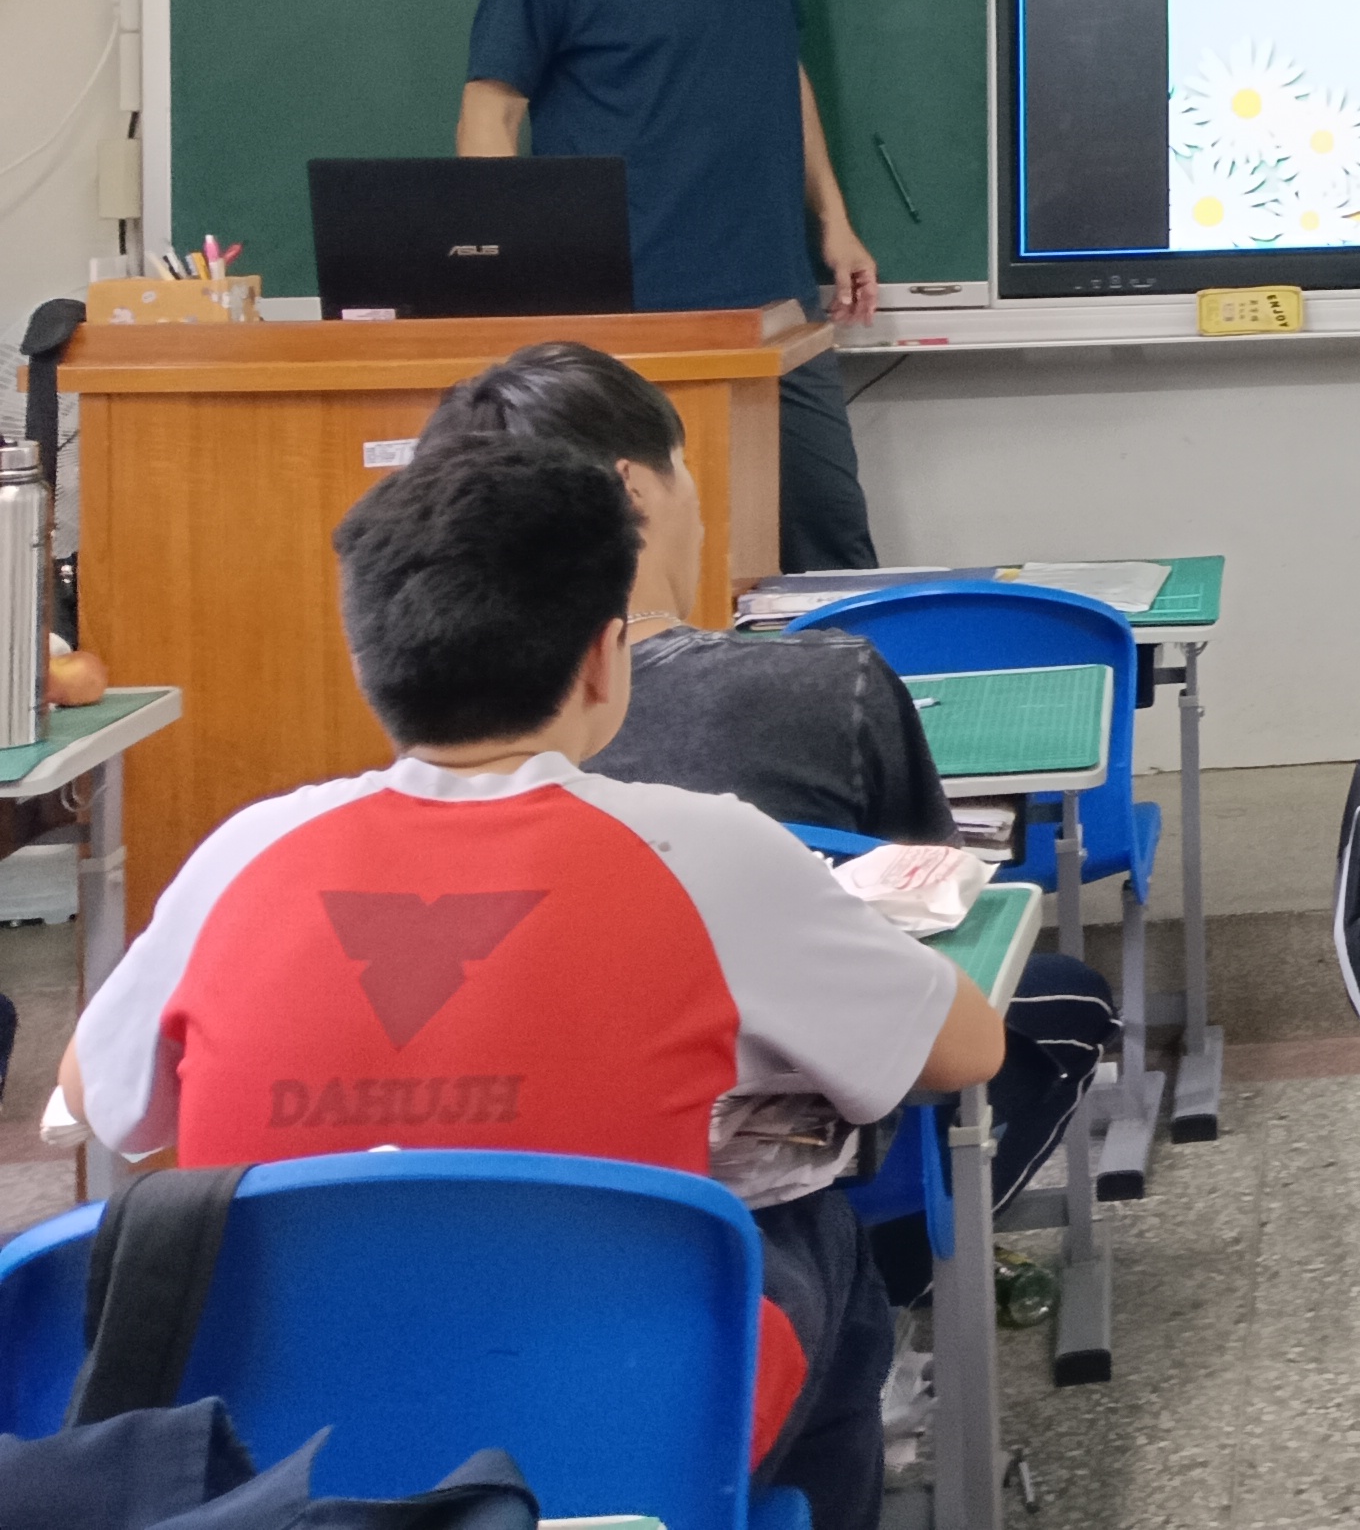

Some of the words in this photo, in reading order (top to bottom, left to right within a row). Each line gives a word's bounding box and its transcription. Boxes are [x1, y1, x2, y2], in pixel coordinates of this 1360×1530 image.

[448, 244, 499, 257] ASUS
[1267, 294, 1290, 328] ENJOY
[267, 1073, 528, 1129] DAHUJH
